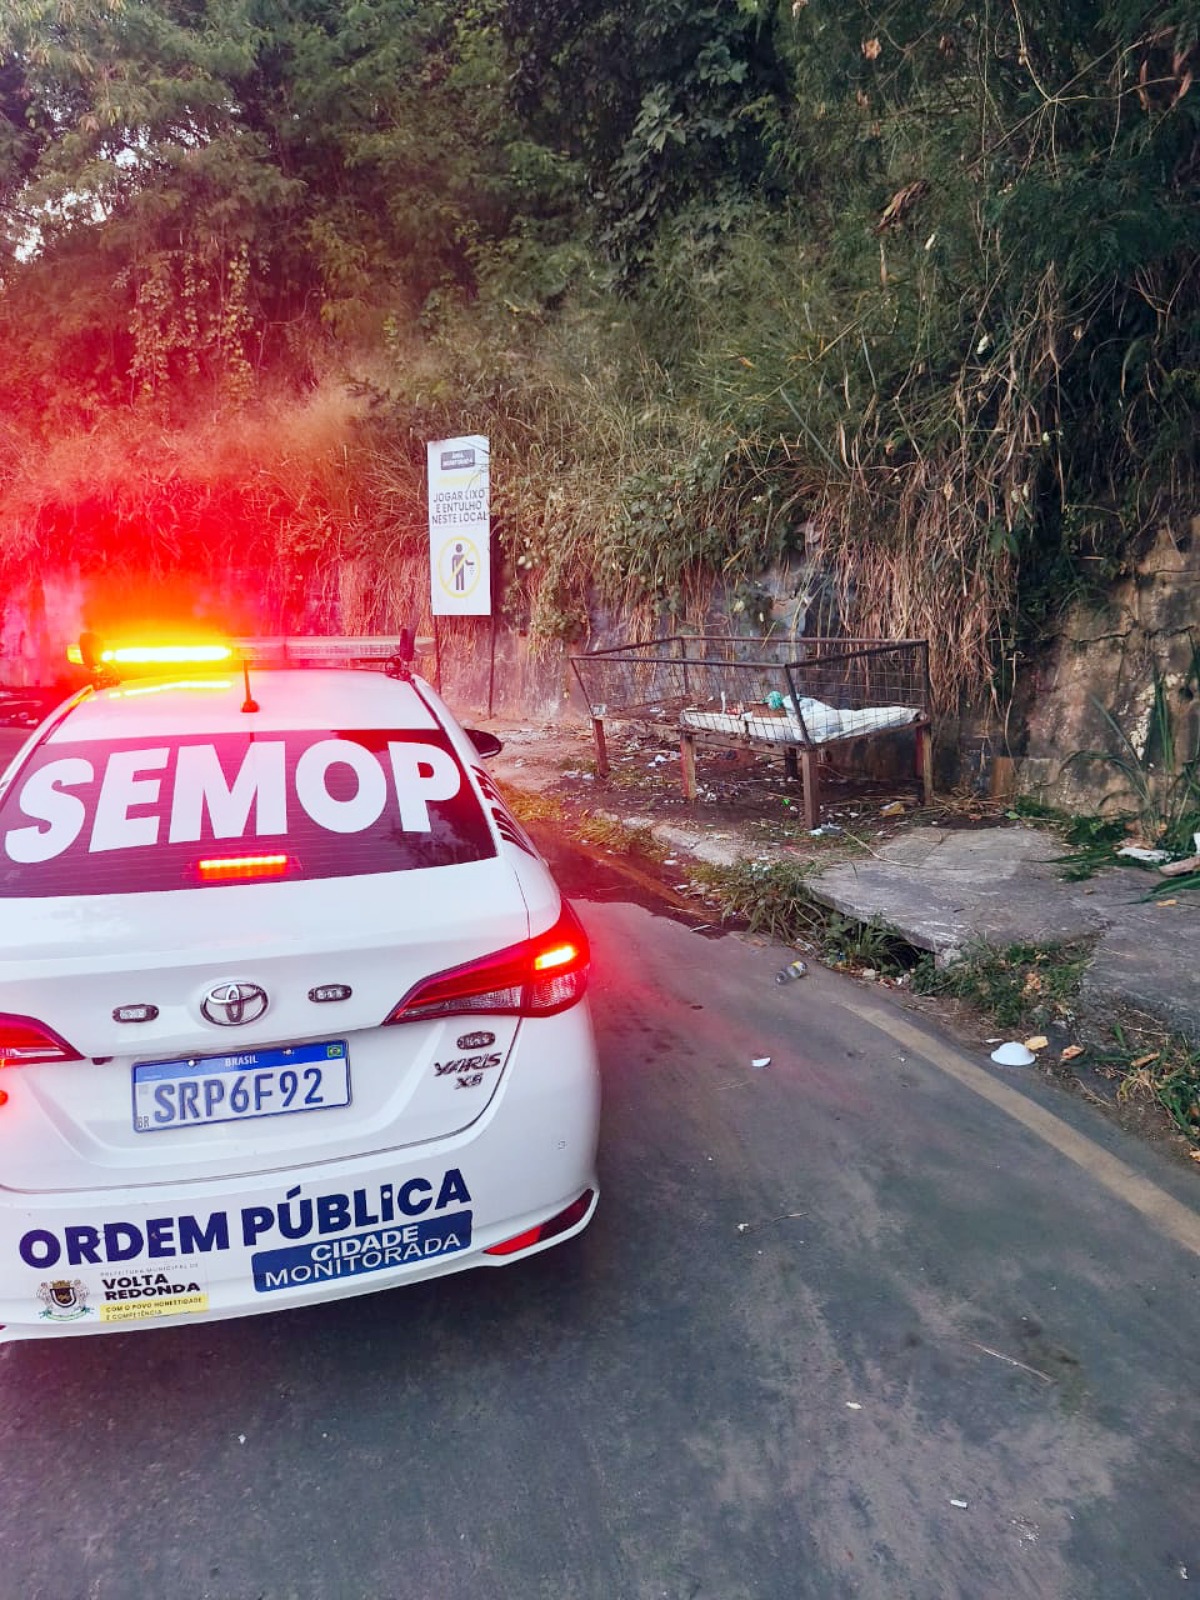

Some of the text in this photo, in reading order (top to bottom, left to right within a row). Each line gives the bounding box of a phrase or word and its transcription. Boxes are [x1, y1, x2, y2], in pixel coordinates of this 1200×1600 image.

[433, 491, 463, 502] JOGAR
[436, 501, 482, 513] E ENTULHO
[432, 511, 488, 525] NESTE LOCAL
[4, 740, 461, 863] SEMOP
[225, 1055, 258, 1067] BRASIL
[434, 1052, 502, 1077] YARIS
[154, 1068, 324, 1123] SRP6F92
[137, 1115, 150, 1129] BR
[19, 1168, 472, 1269] ORDEM PÚBLICA
[310, 1225, 419, 1262] CIDADE
[265, 1233, 461, 1287] MONITORADA
[102, 1273, 168, 1290] VOLTA
[105, 1282, 200, 1301] REDONDA
